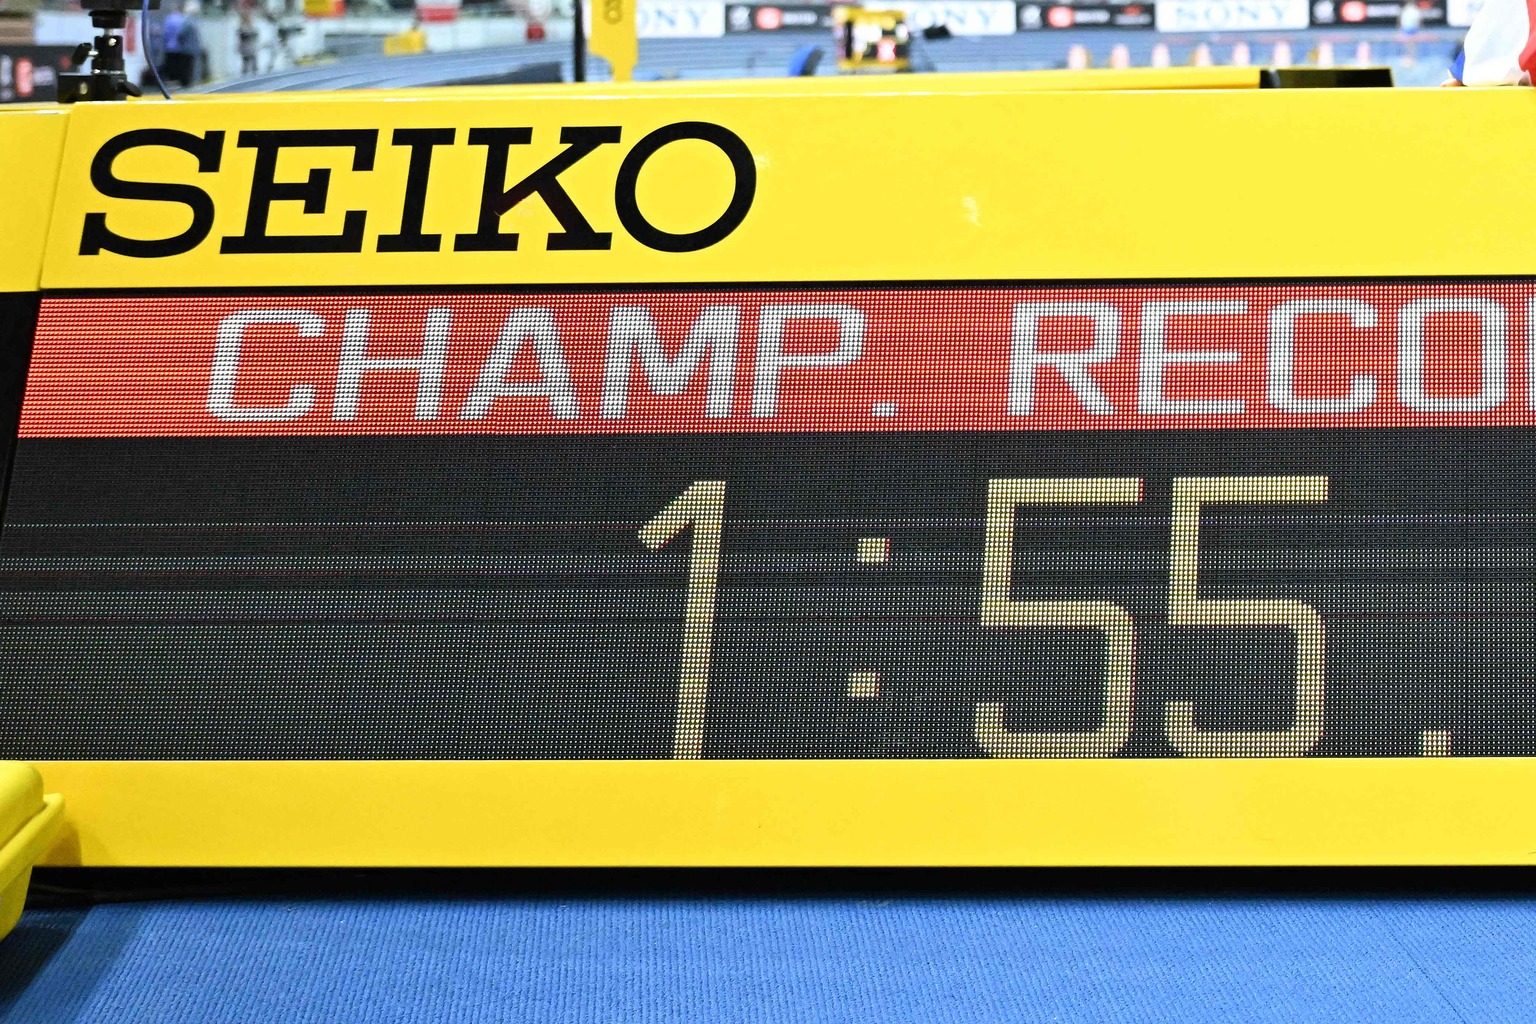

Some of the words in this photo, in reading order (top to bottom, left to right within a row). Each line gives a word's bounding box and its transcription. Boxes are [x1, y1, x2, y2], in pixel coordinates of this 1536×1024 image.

[1174, 3, 1289, 25] SONY
[78, 121, 757, 258] SEIKO
[206, 303, 896, 422] CHAMP.
